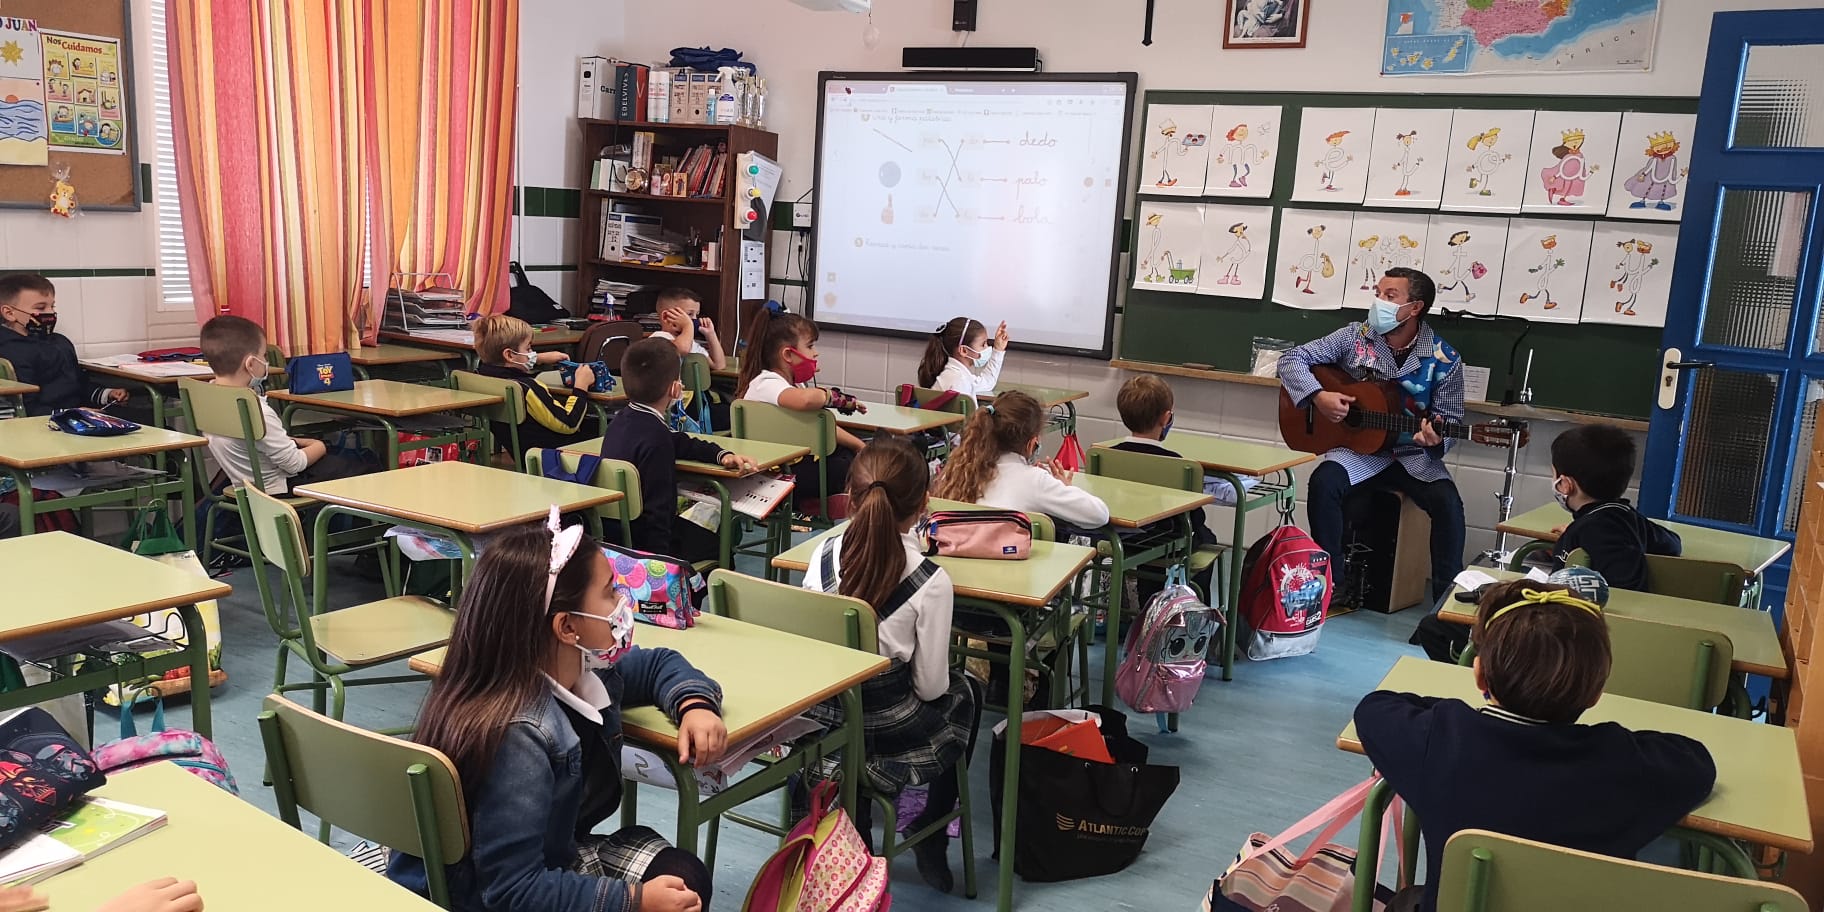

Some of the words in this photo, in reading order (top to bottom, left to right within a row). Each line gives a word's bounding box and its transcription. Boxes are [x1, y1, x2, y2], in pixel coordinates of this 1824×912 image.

[5, 18, 37, 31] JUAN
[46, 35, 61, 45] Nos
[621, 71, 630, 117] EDELVIVES
[1019, 130, 1057, 147] dedo
[316, 365, 334, 375] TOY
[1078, 818, 1128, 836] ATLANTIC
